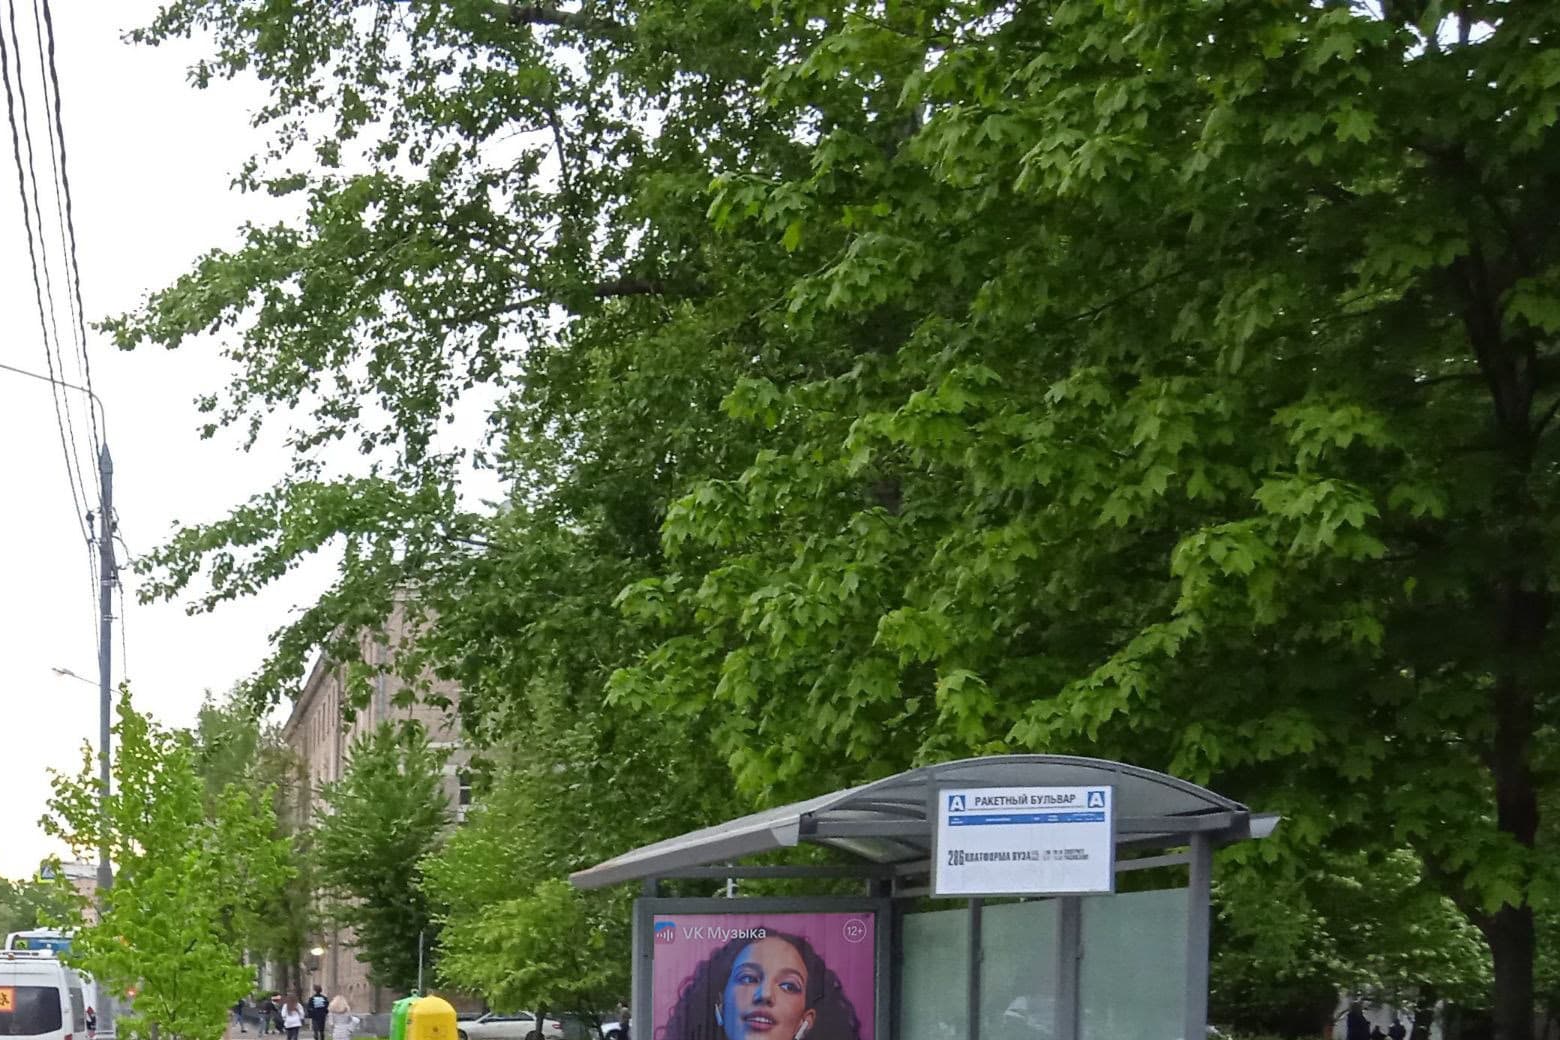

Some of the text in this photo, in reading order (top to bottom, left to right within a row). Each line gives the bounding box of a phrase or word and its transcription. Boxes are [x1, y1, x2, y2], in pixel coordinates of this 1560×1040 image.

[975, 793, 1076, 806] РАКЕТНЫЙ БУЛЬВАР
[948, 850, 964, 866] 286
[683, 927, 767, 943] VK Музыка
[846, 925, 864, 937] 12+
